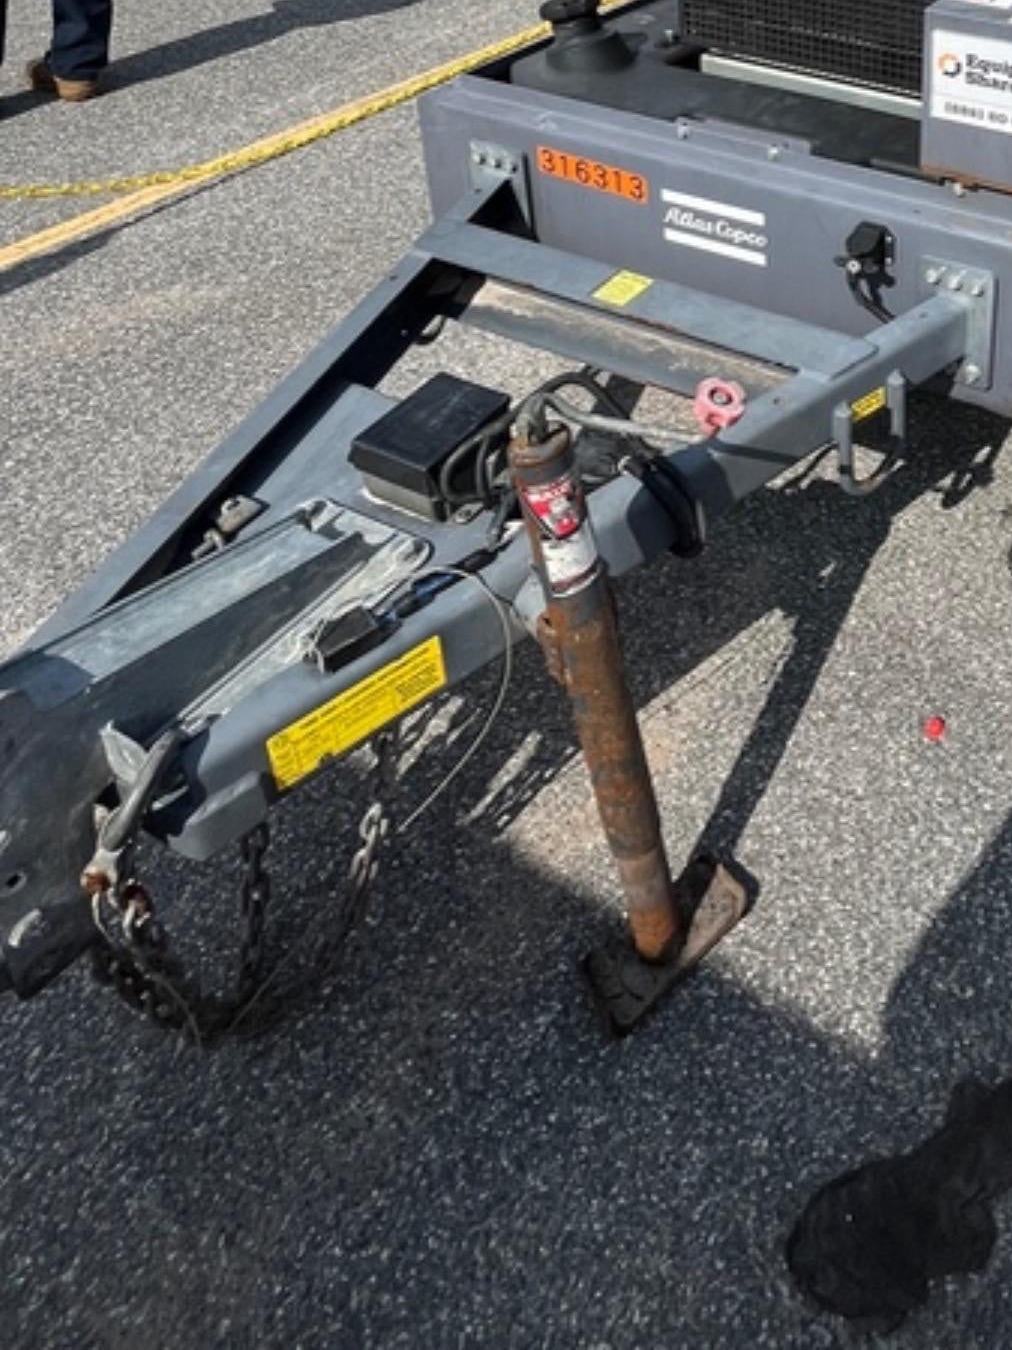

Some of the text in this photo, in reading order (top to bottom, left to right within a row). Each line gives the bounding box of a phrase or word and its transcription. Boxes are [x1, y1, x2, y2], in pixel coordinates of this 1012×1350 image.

[541, 149, 645, 200] 316313
[663, 207, 768, 248] Atlas Copco
